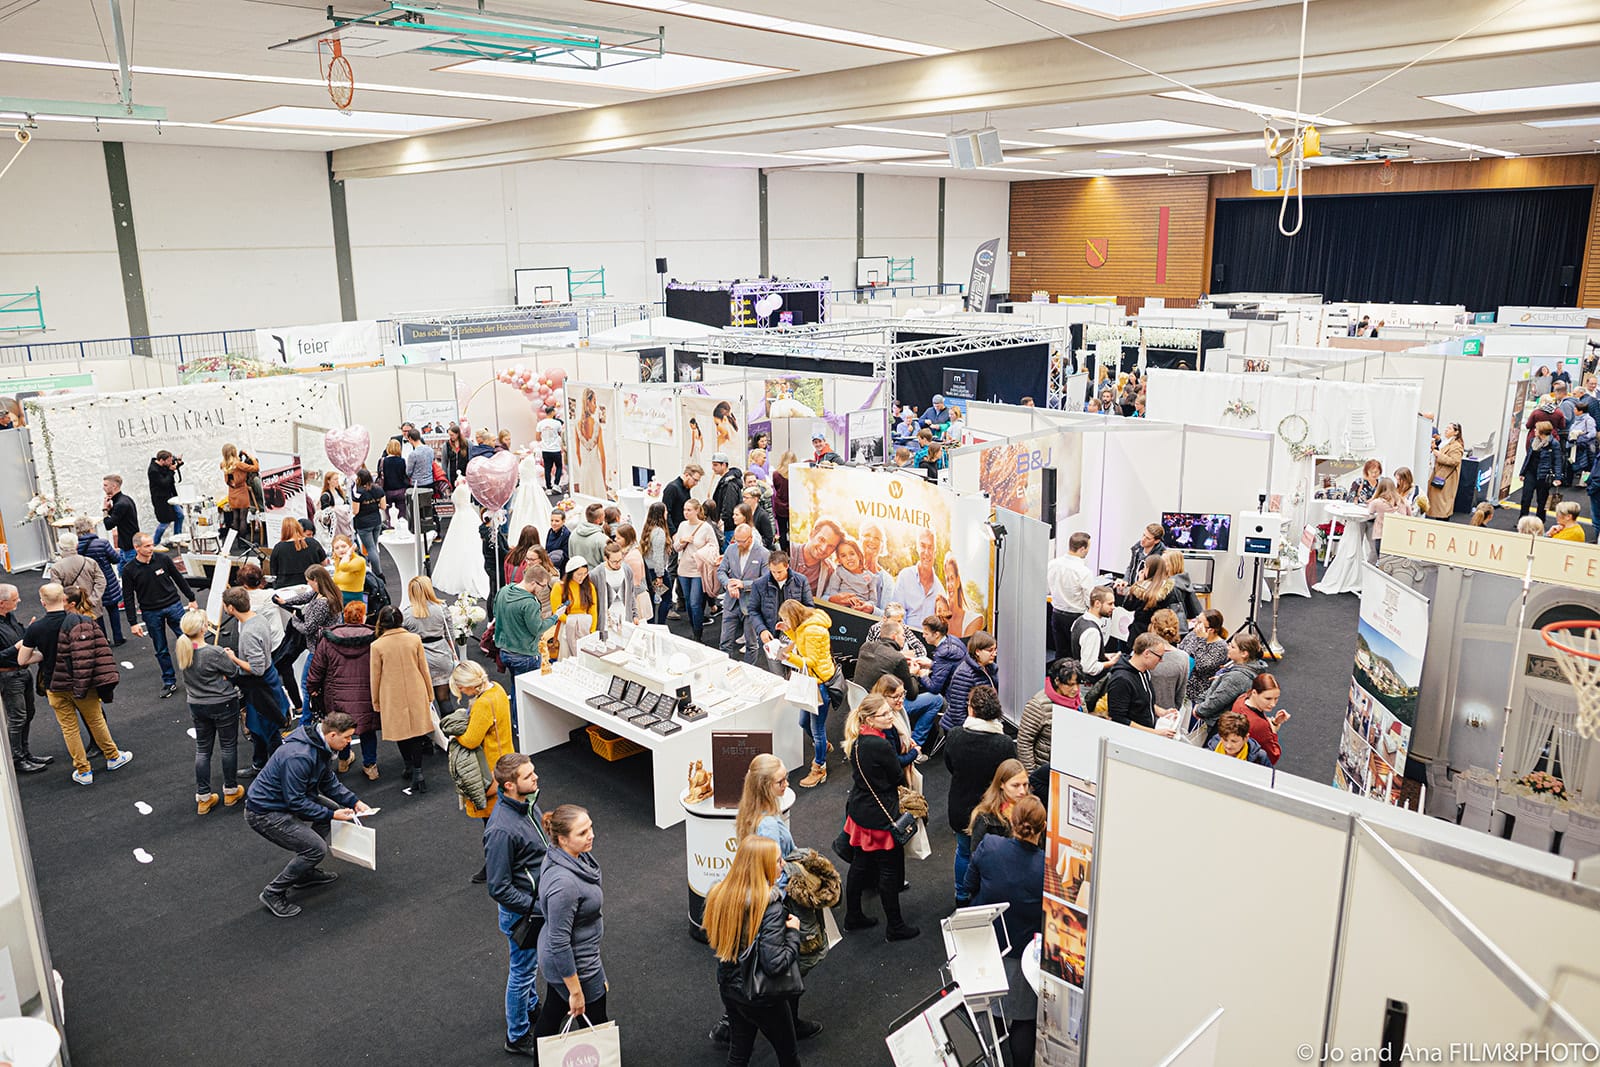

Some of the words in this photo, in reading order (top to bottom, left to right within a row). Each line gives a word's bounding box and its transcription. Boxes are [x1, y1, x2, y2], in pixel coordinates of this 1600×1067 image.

[298, 338, 330, 355] feier
[1017, 447, 1052, 474] B&J
[855, 500, 931, 529] WIDMAIER
[1407, 529, 1504, 562] TRAUM
